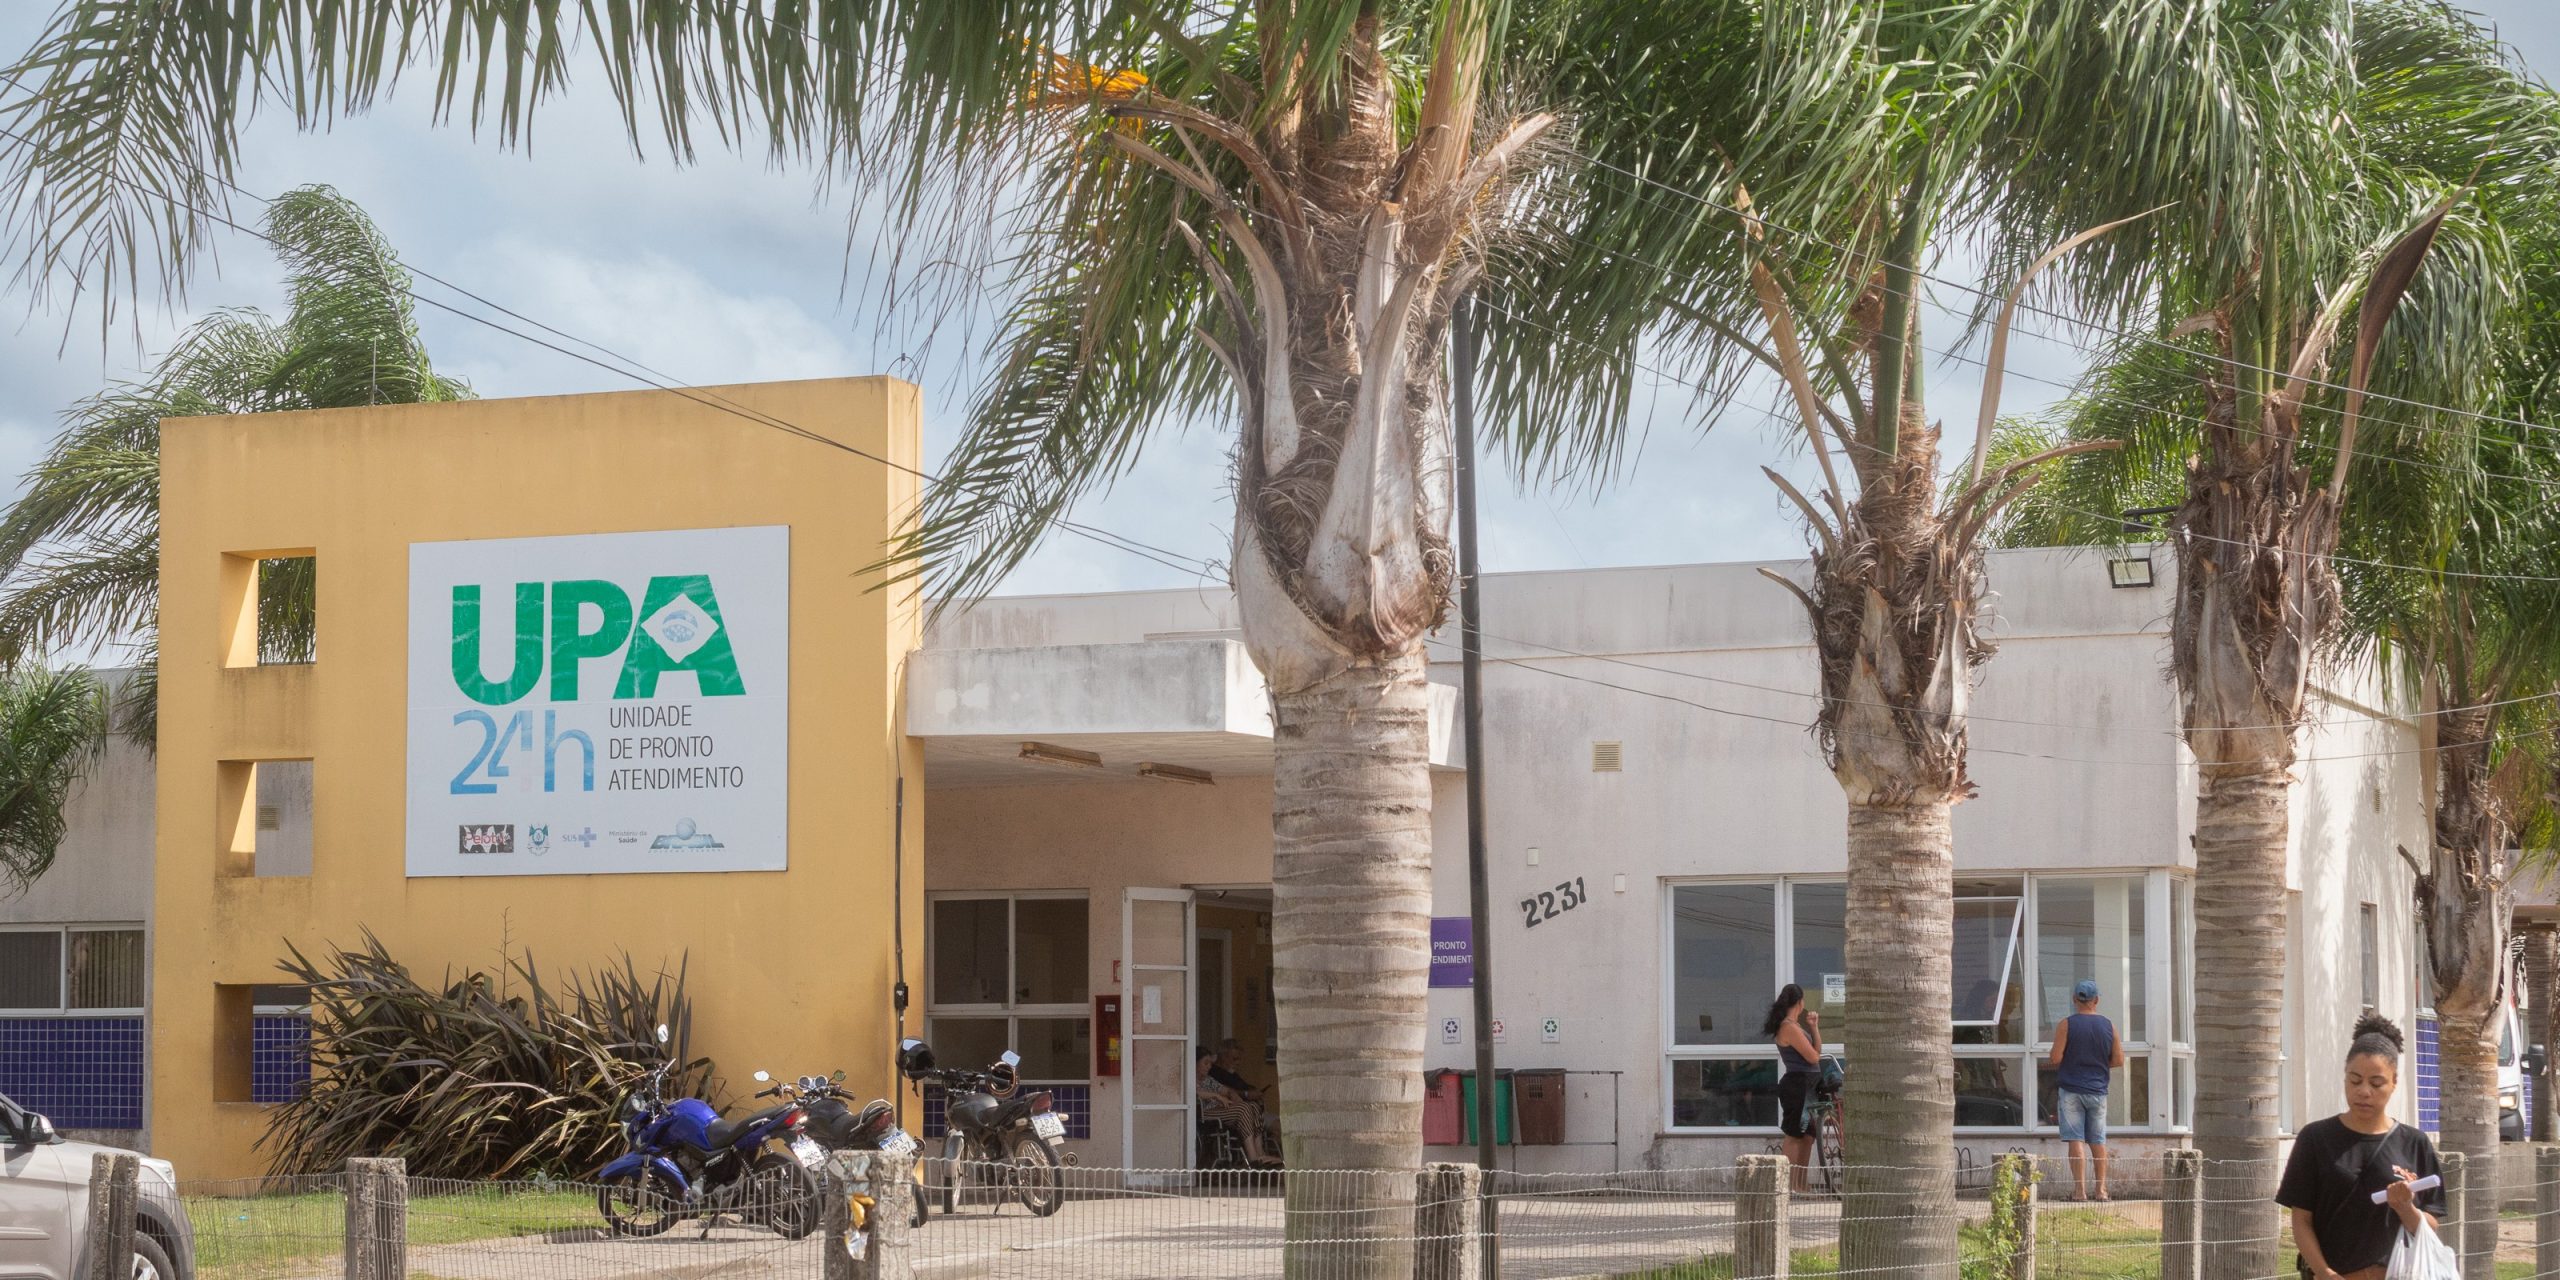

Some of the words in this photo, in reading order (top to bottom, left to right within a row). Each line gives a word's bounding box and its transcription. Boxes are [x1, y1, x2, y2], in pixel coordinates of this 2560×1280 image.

[452, 575, 747, 706] UPA
[609, 705, 692, 728] UNIDADE
[450, 709, 595, 795] 24h
[609, 737, 633, 759] DE
[640, 735, 714, 758] PRONTO
[608, 765, 744, 790] ATENDIMENTO
[1521, 876, 1587, 928] 2231
[1433, 941, 1467, 950] PRONTO
[1431, 955, 1473, 964] ENDIMENT
